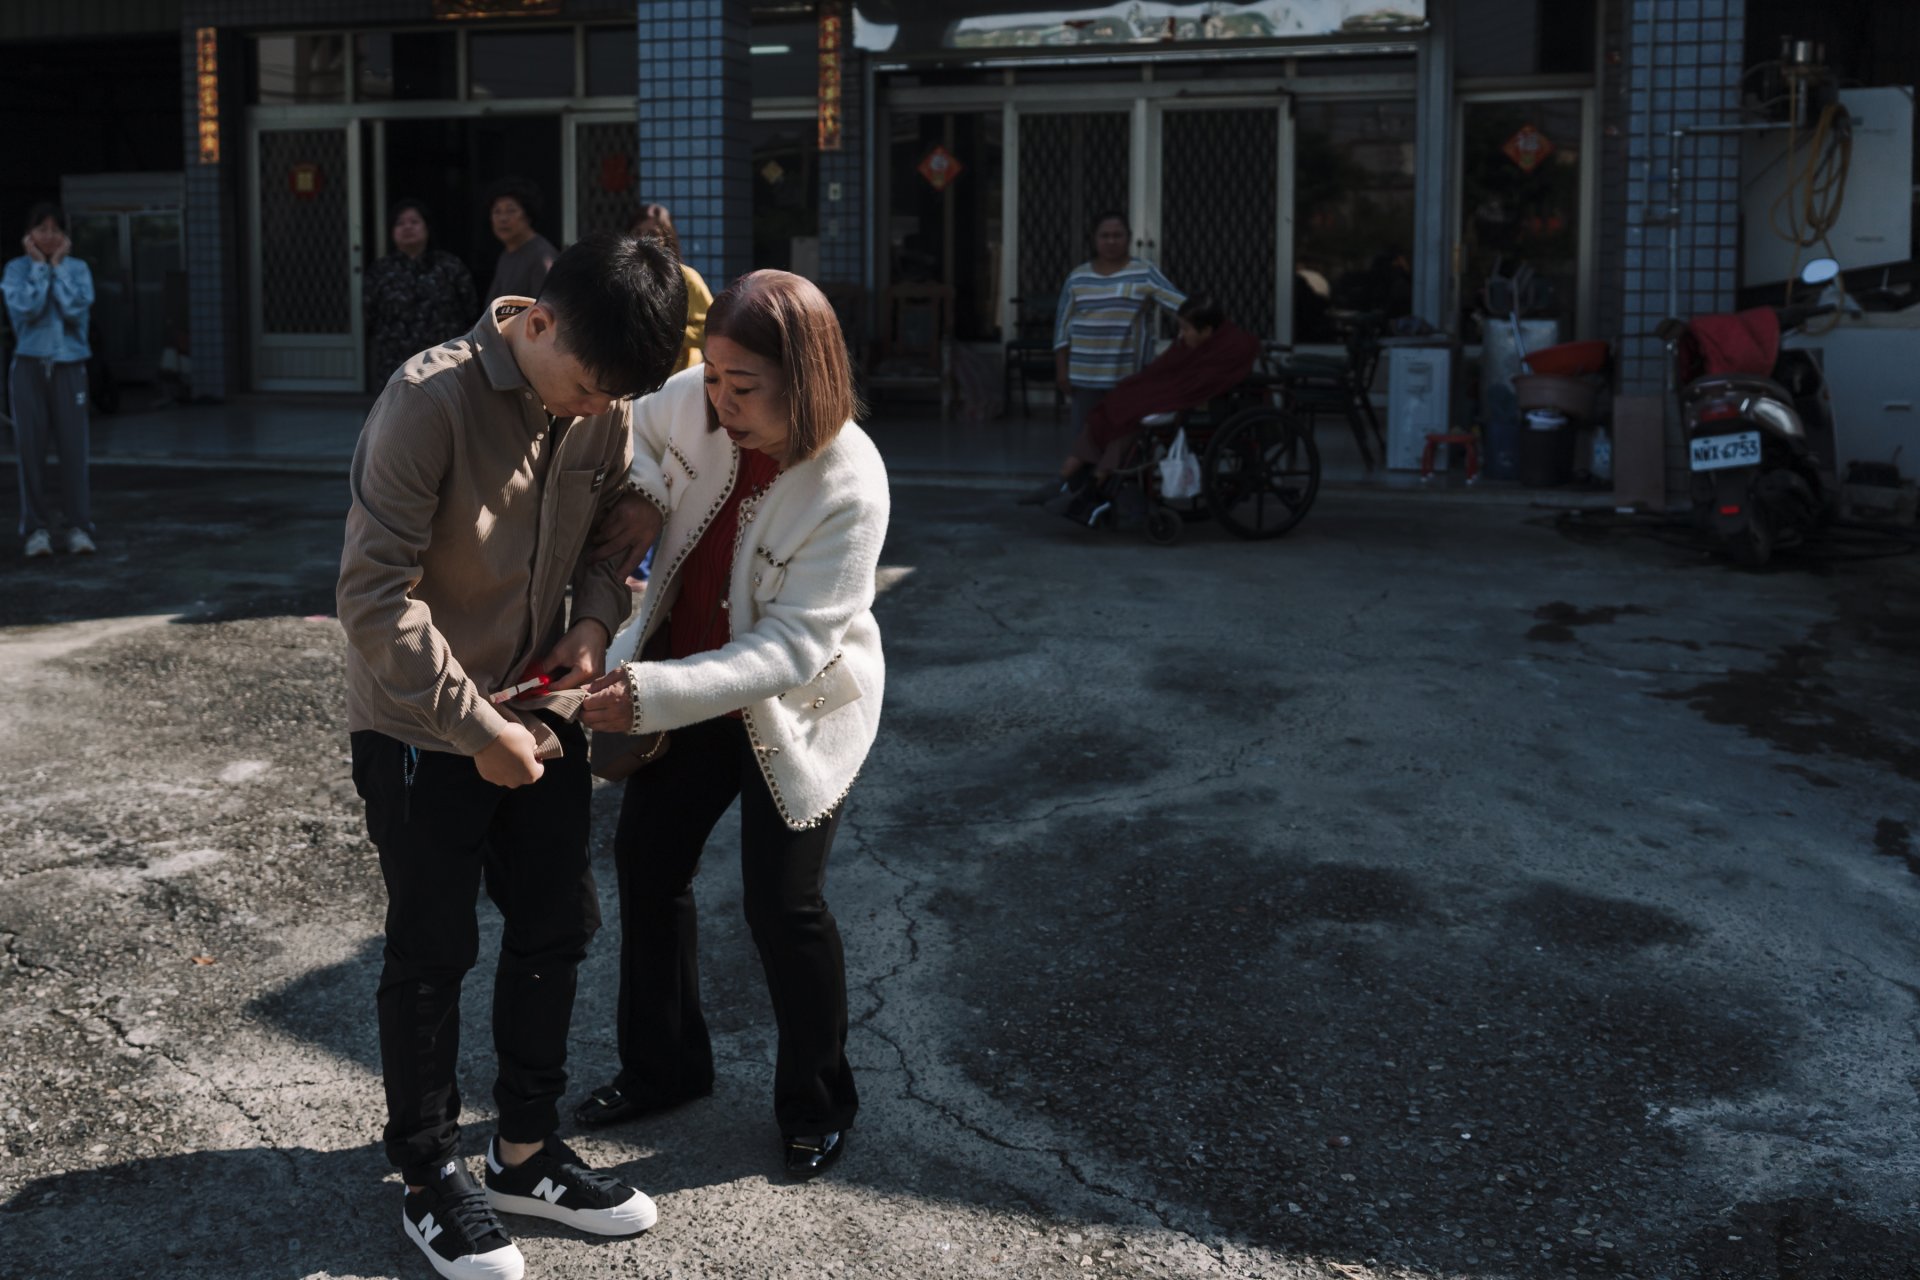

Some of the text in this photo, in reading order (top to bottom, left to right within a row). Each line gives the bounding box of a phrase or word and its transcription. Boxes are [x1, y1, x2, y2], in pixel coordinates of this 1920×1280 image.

[440, 1161, 456, 1180] NB
[531, 1176, 568, 1204] N
[418, 1213, 443, 1245] N
